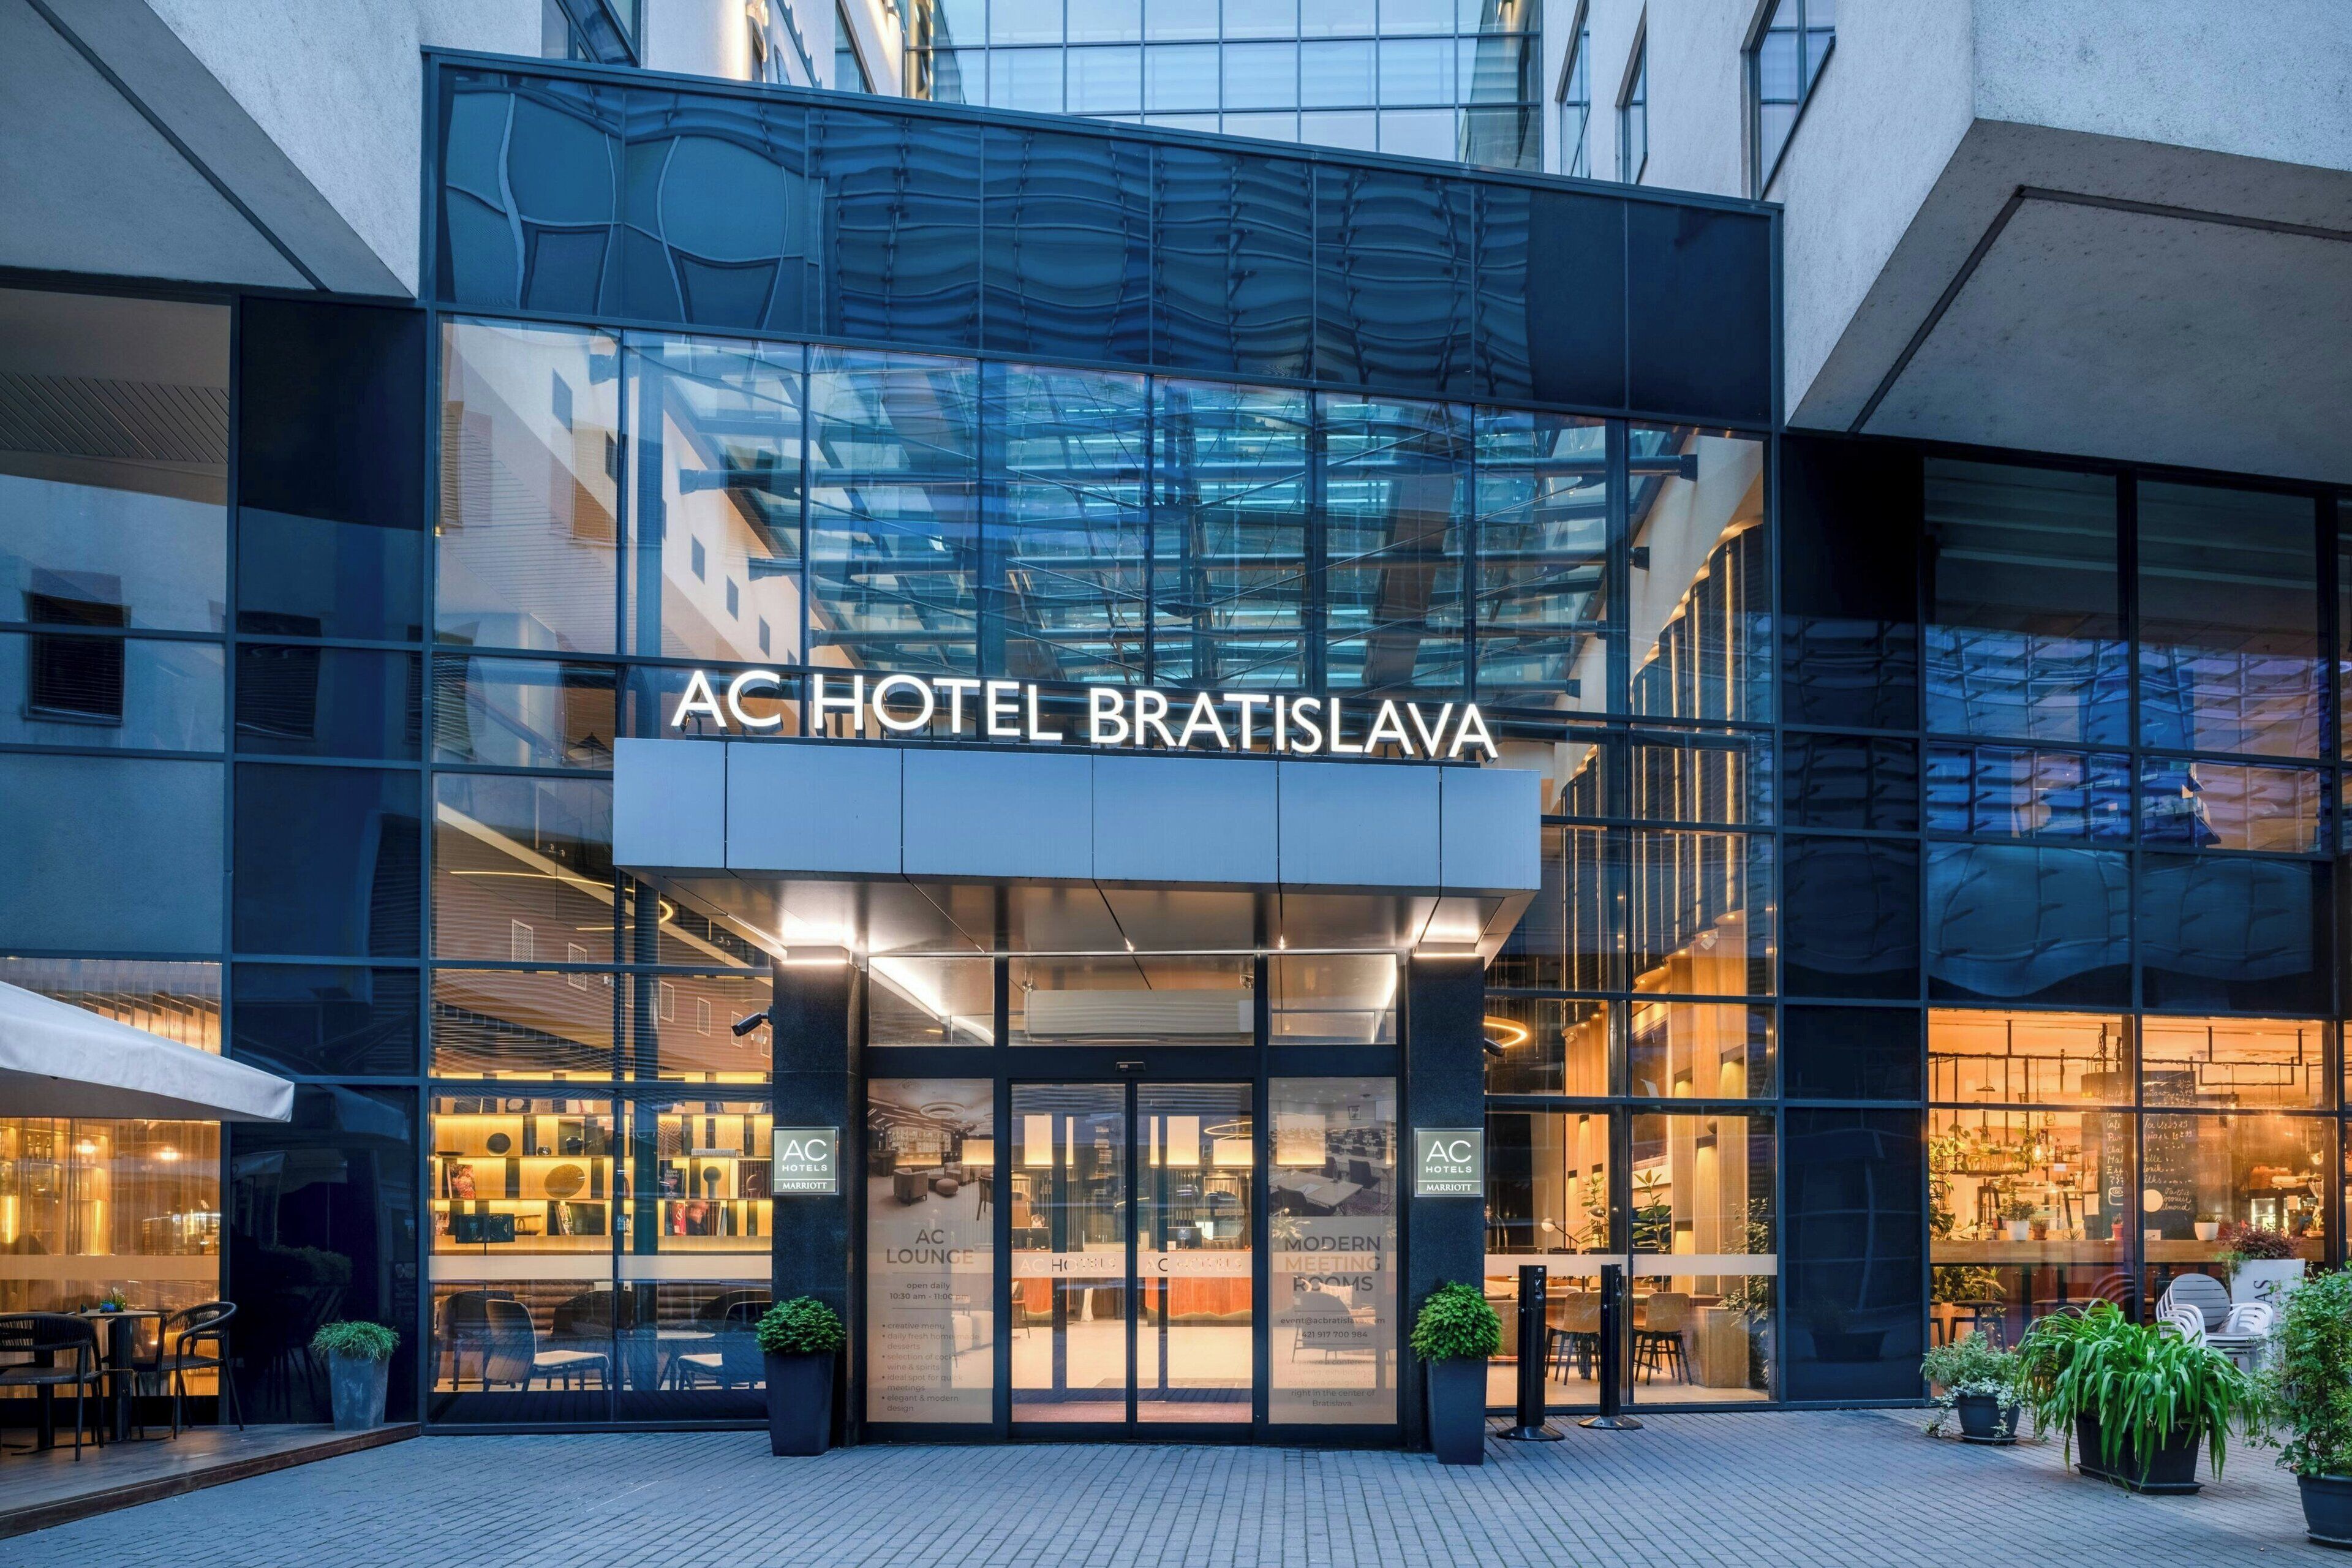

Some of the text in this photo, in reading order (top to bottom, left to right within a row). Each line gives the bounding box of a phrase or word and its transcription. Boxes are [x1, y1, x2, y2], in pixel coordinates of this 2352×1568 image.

[670, 669, 1499, 761] AC HOTEL BRATISLAVA
[782, 1139, 827, 1161] AC
[1426, 1140, 1472, 1163] AC
[915, 1229, 944, 1244] AC
[1285, 1236, 1381, 1251] MODERN
[886, 1249, 974, 1264] LOUNGE
[1285, 1256, 1381, 1272] MEETING
[1019, 1258, 1117, 1272] AC HOTELS
[1145, 1257, 1243, 1272] AC HOTELS
[1294, 1276, 1373, 1292] ROOMS
[1291, 1389, 1311, 1398] right
